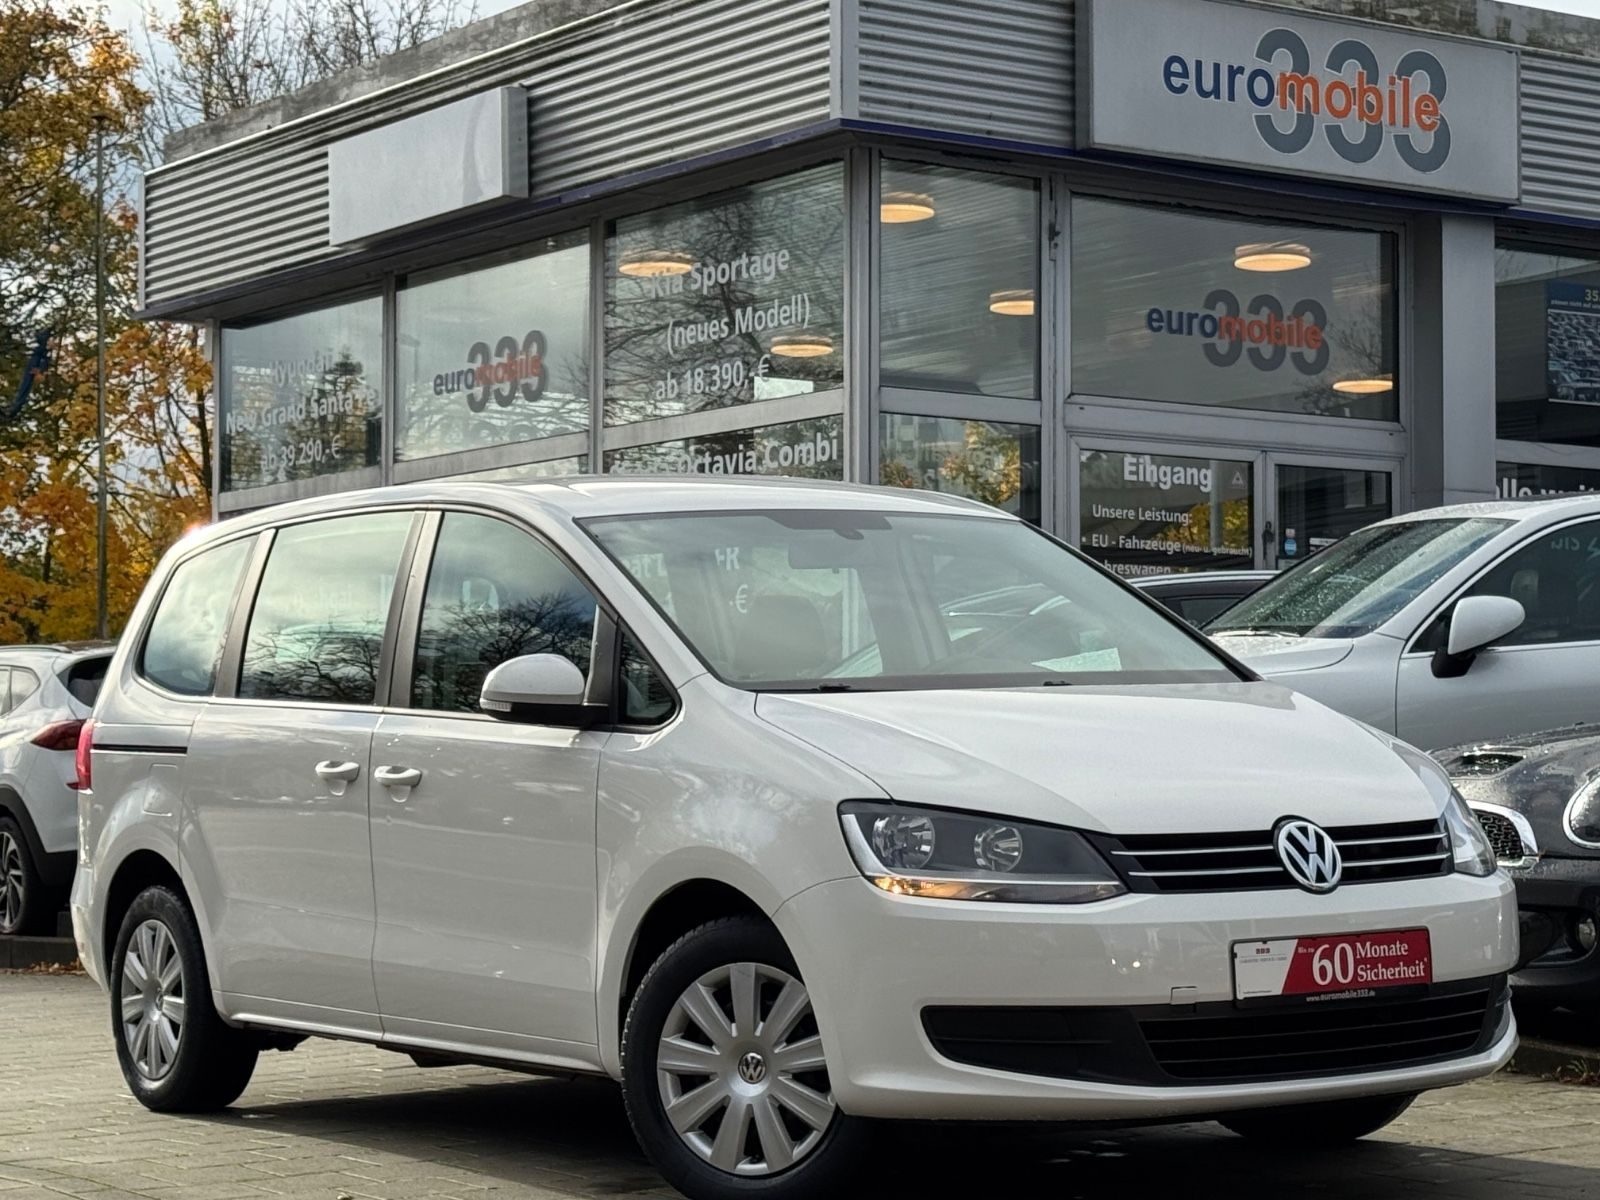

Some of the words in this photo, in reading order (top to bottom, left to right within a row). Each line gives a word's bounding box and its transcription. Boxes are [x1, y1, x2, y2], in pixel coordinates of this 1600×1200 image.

[1162, 53, 1441, 132] euromobile
[691, 248, 790, 295] Sportage
[667, 317, 730, 356] (neues
[734, 292, 810, 334] Modell)
[1146, 306, 1324, 350] euromobile
[433, 354, 543, 397] euromobile
[655, 371, 678, 401] ab
[261, 397, 306, 427] Grand
[765, 432, 838, 469] Combi
[1123, 454, 1213, 493] Eingang
[1092, 504, 1136, 520] Unsere
[1138, 507, 1193, 527] Leistung:
[1091, 533, 1109, 548] EU
[1118, 535, 1182, 555] Fahrzeuge
[1312, 942, 1355, 986] 60
[1355, 940, 1409, 959] Monate
